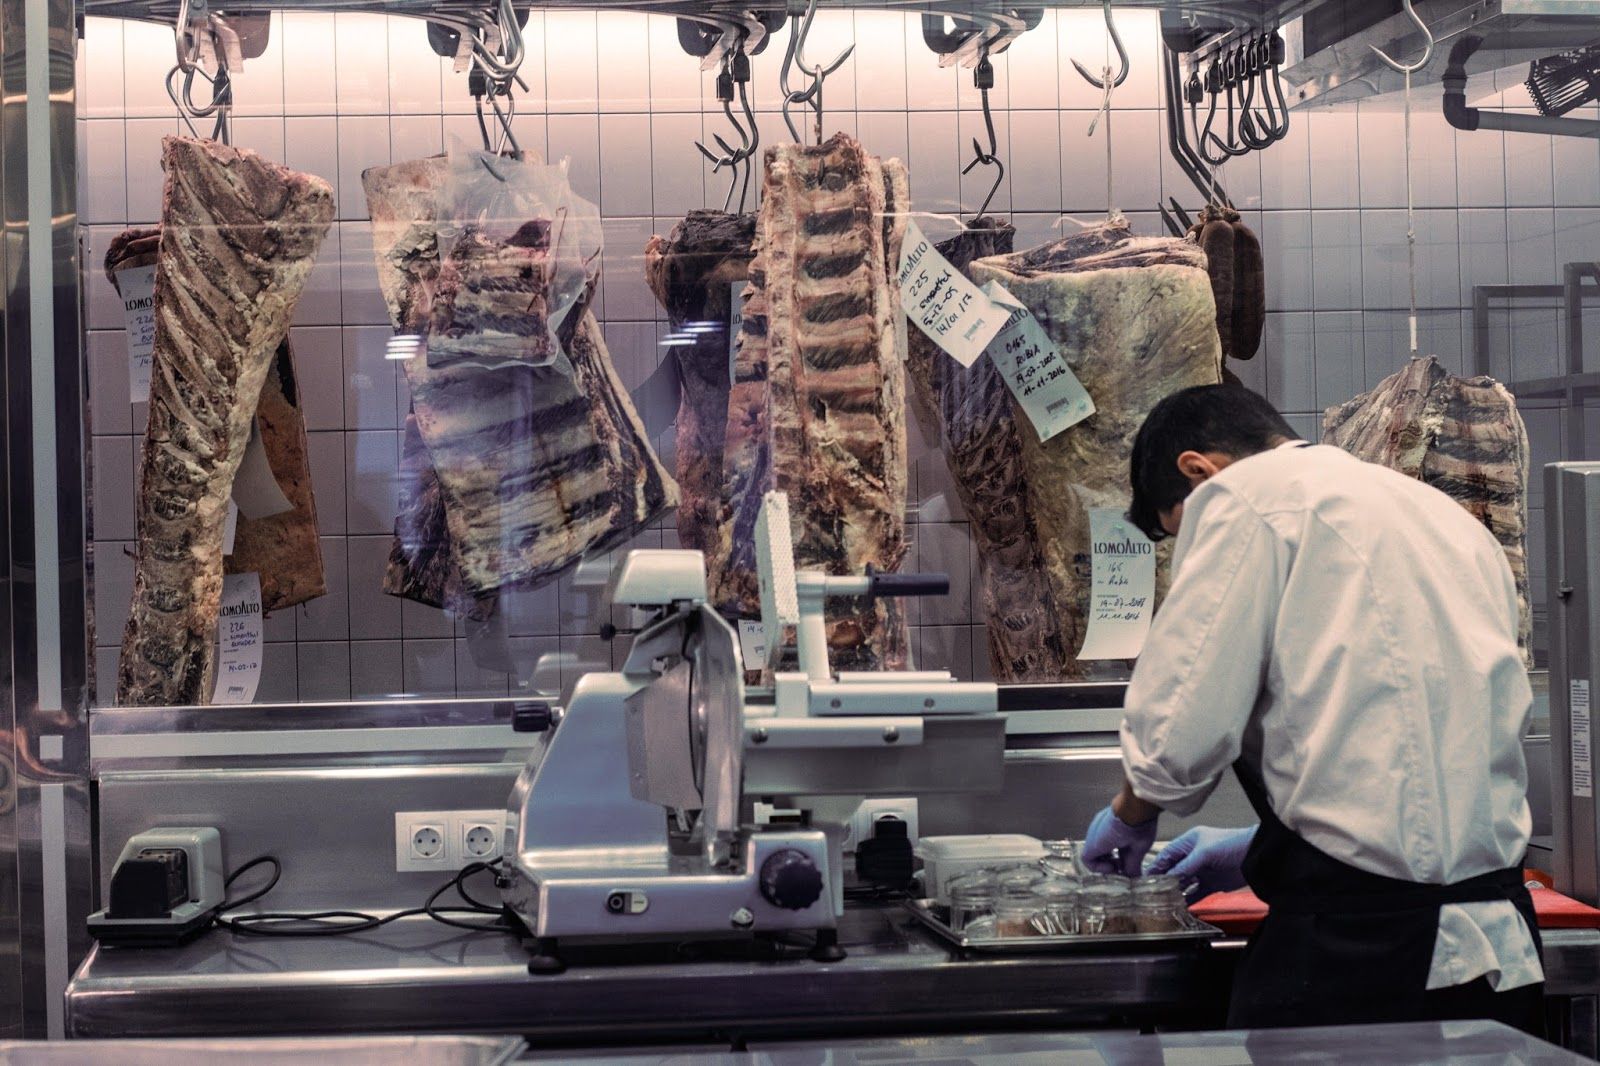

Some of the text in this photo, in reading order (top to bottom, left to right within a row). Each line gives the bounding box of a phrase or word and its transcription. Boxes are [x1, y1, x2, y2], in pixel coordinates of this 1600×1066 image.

[909, 269, 929, 297] 225
[1094, 538, 1151, 555] LOMOALTO
[220, 601, 260, 616] LOMOALTO
